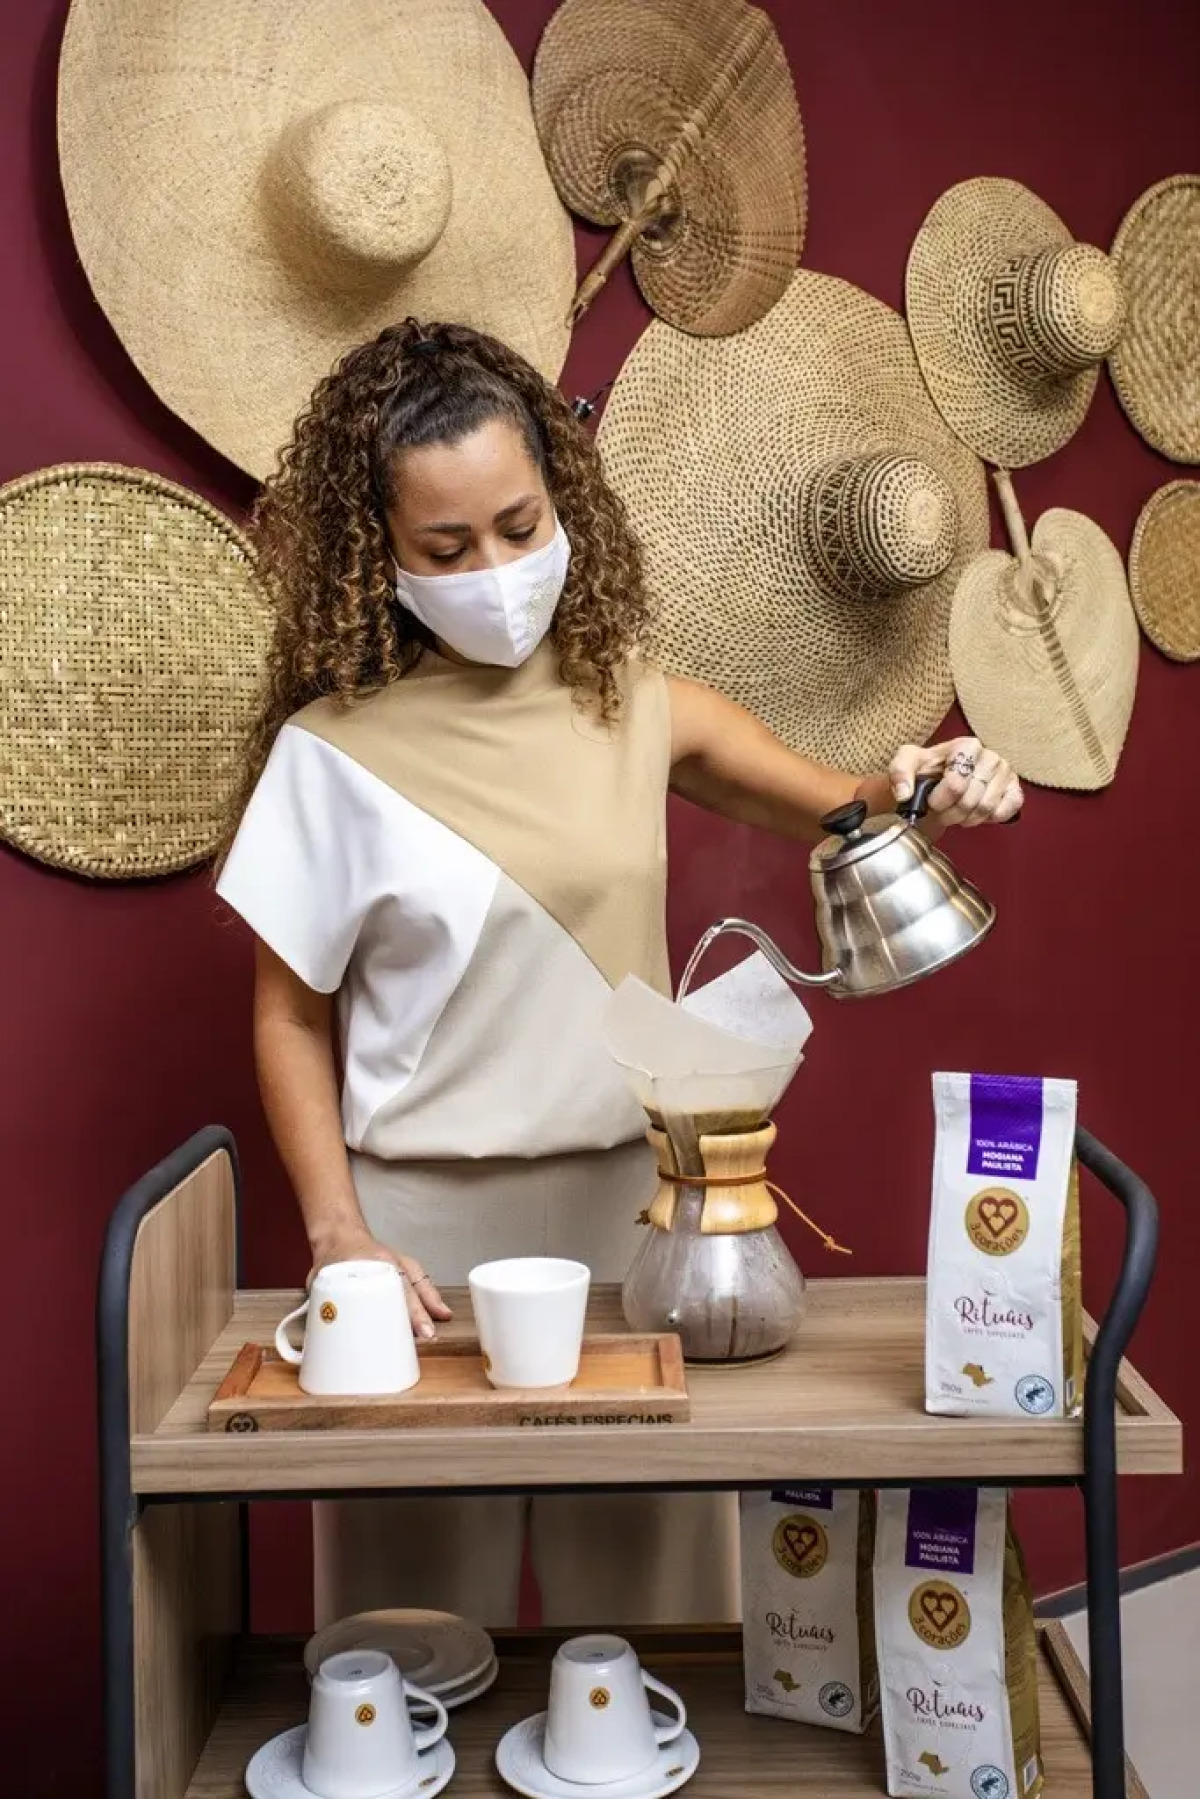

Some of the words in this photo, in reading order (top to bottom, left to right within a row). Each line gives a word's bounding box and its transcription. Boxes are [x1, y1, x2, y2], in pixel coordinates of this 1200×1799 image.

[981, 1151, 1025, 1162] MOGIANA
[981, 1160, 1023, 1171] PAULISTA
[953, 1296, 1034, 1331] Rituais
[582, 1413, 674, 1426] ESPECIAIS
[919, 1543, 960, 1555] MOGIANA
[919, 1552, 960, 1565] PAULISTA
[765, 1612, 836, 1644] Rituais
[906, 1687, 985, 1723] Rituais
